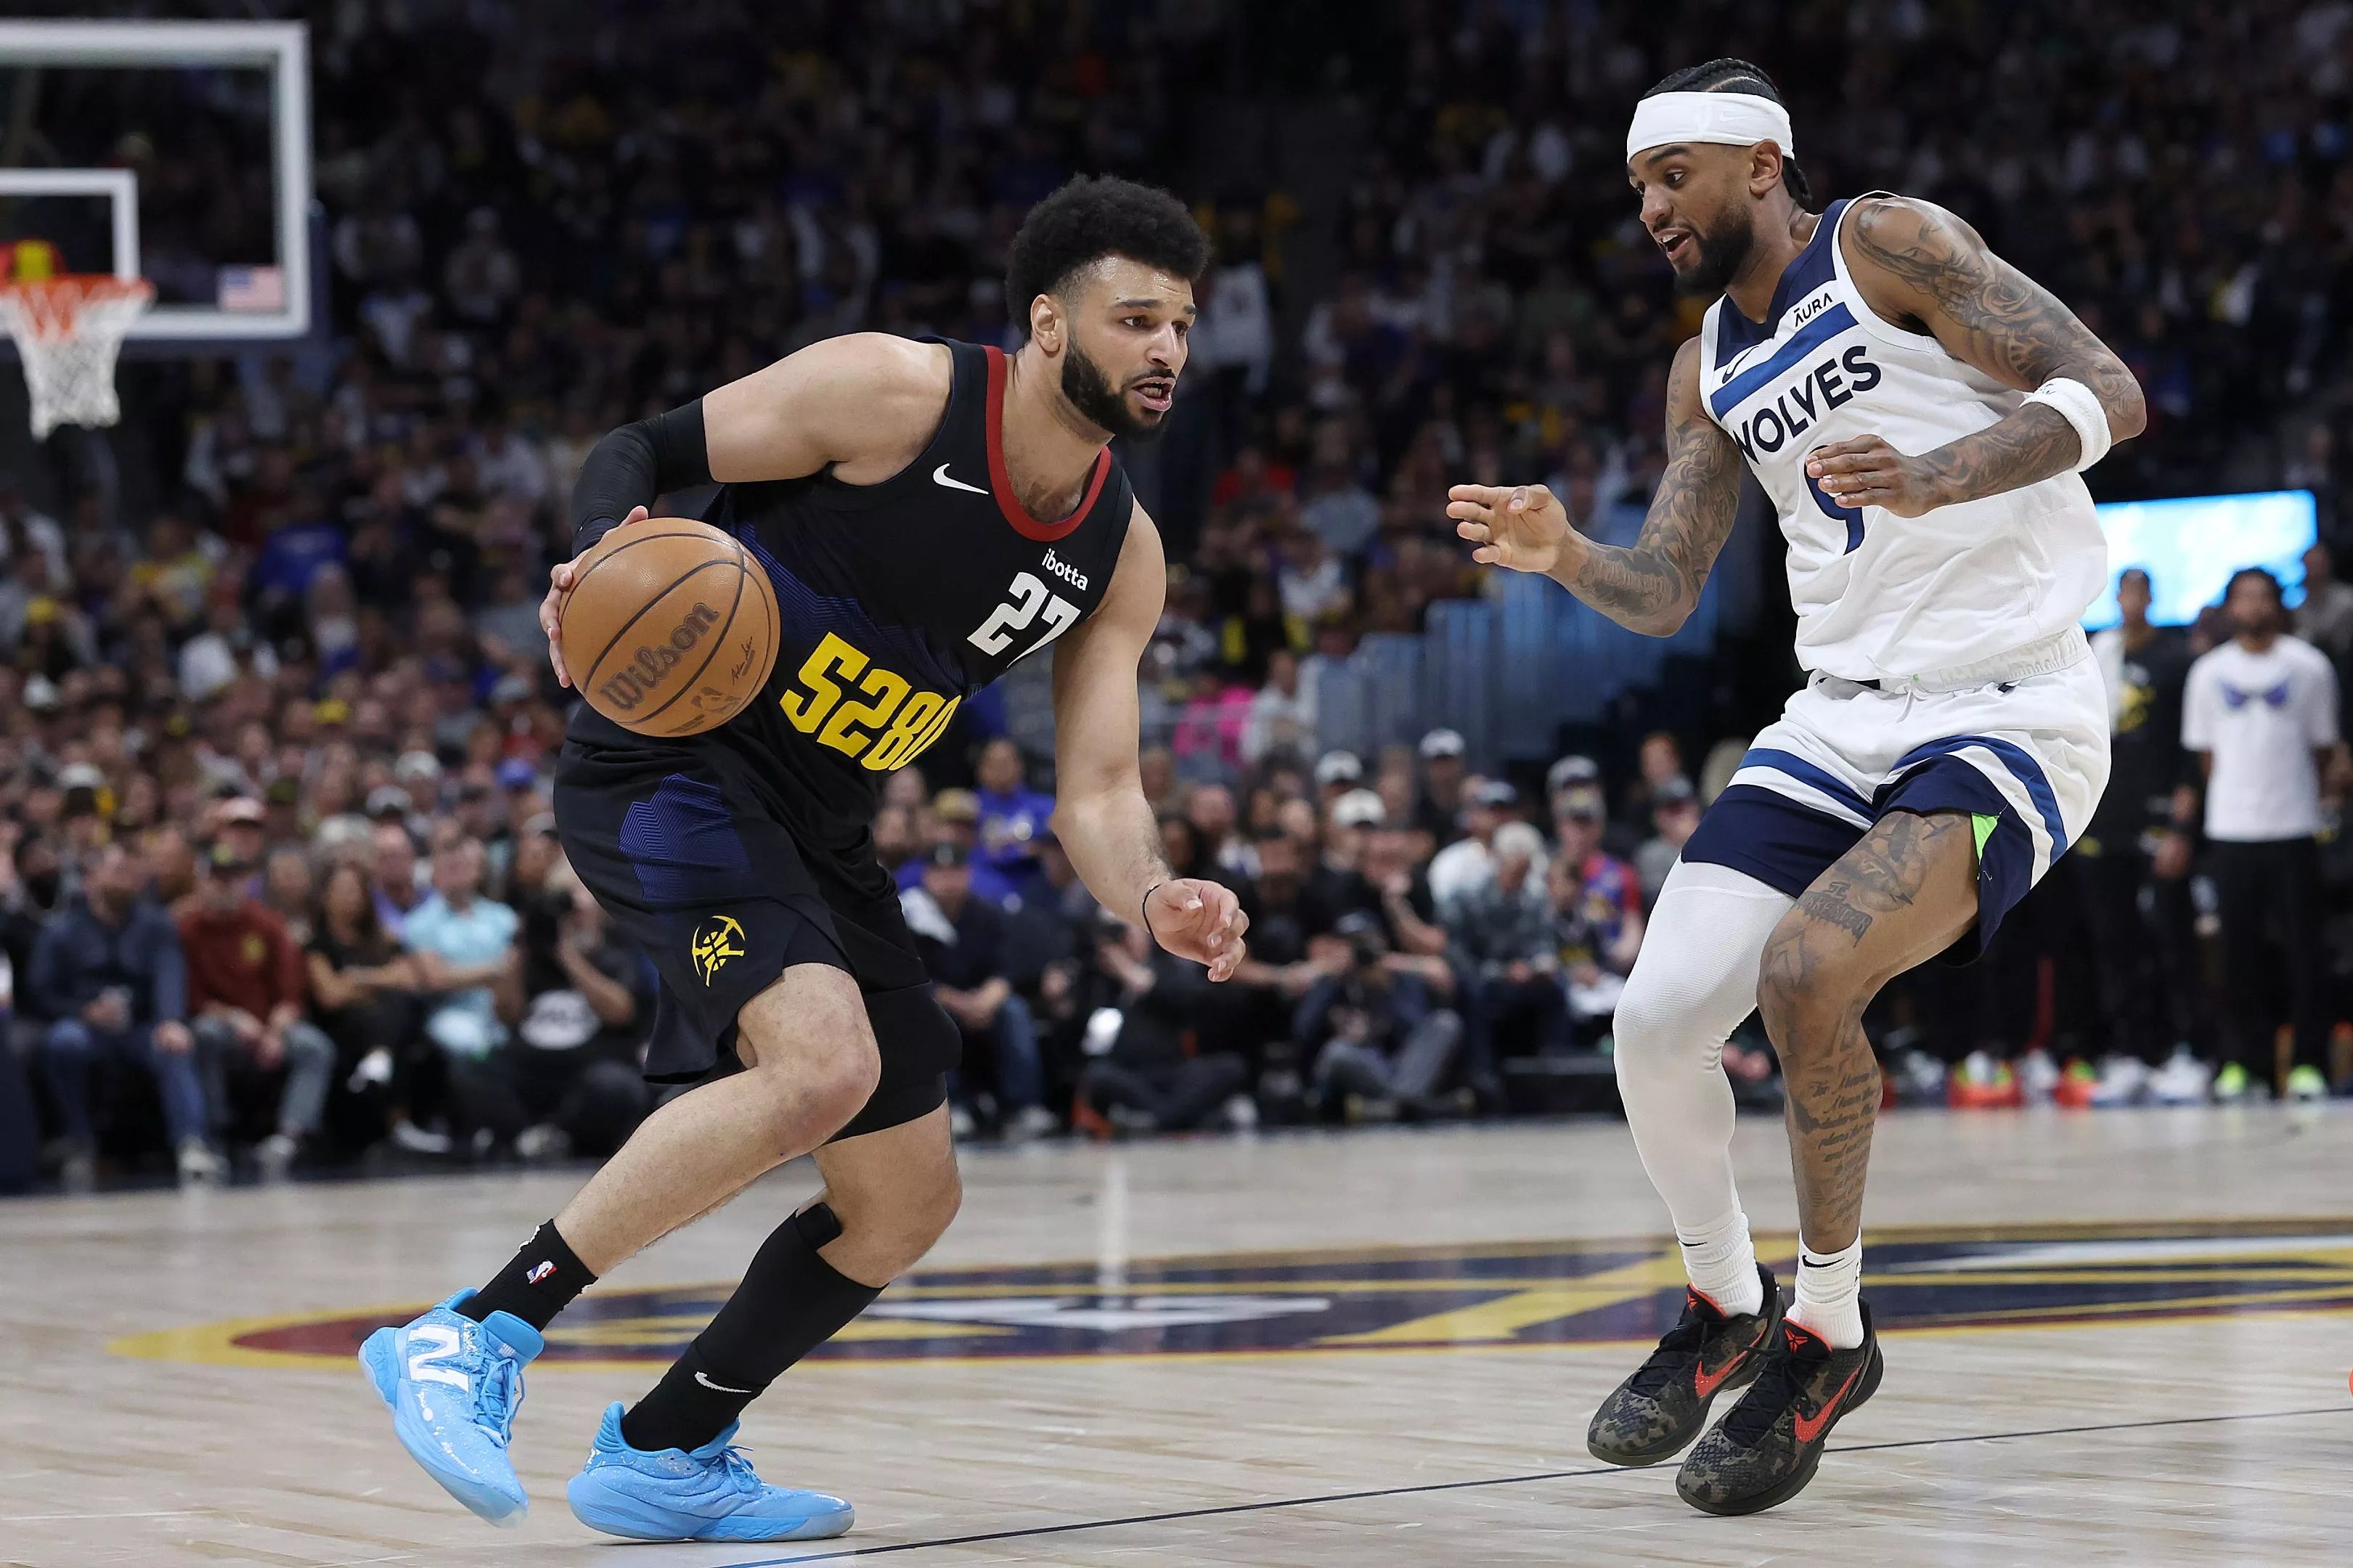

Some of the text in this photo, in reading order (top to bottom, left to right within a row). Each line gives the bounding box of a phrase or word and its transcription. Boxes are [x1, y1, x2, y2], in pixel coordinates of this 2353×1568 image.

[1732, 346, 1882, 465] WOLVES
[966, 571, 1082, 669] 27
[1041, 547, 1089, 591] ibotta
[599, 603, 721, 711] Wilson
[779, 631, 962, 771] 5280
